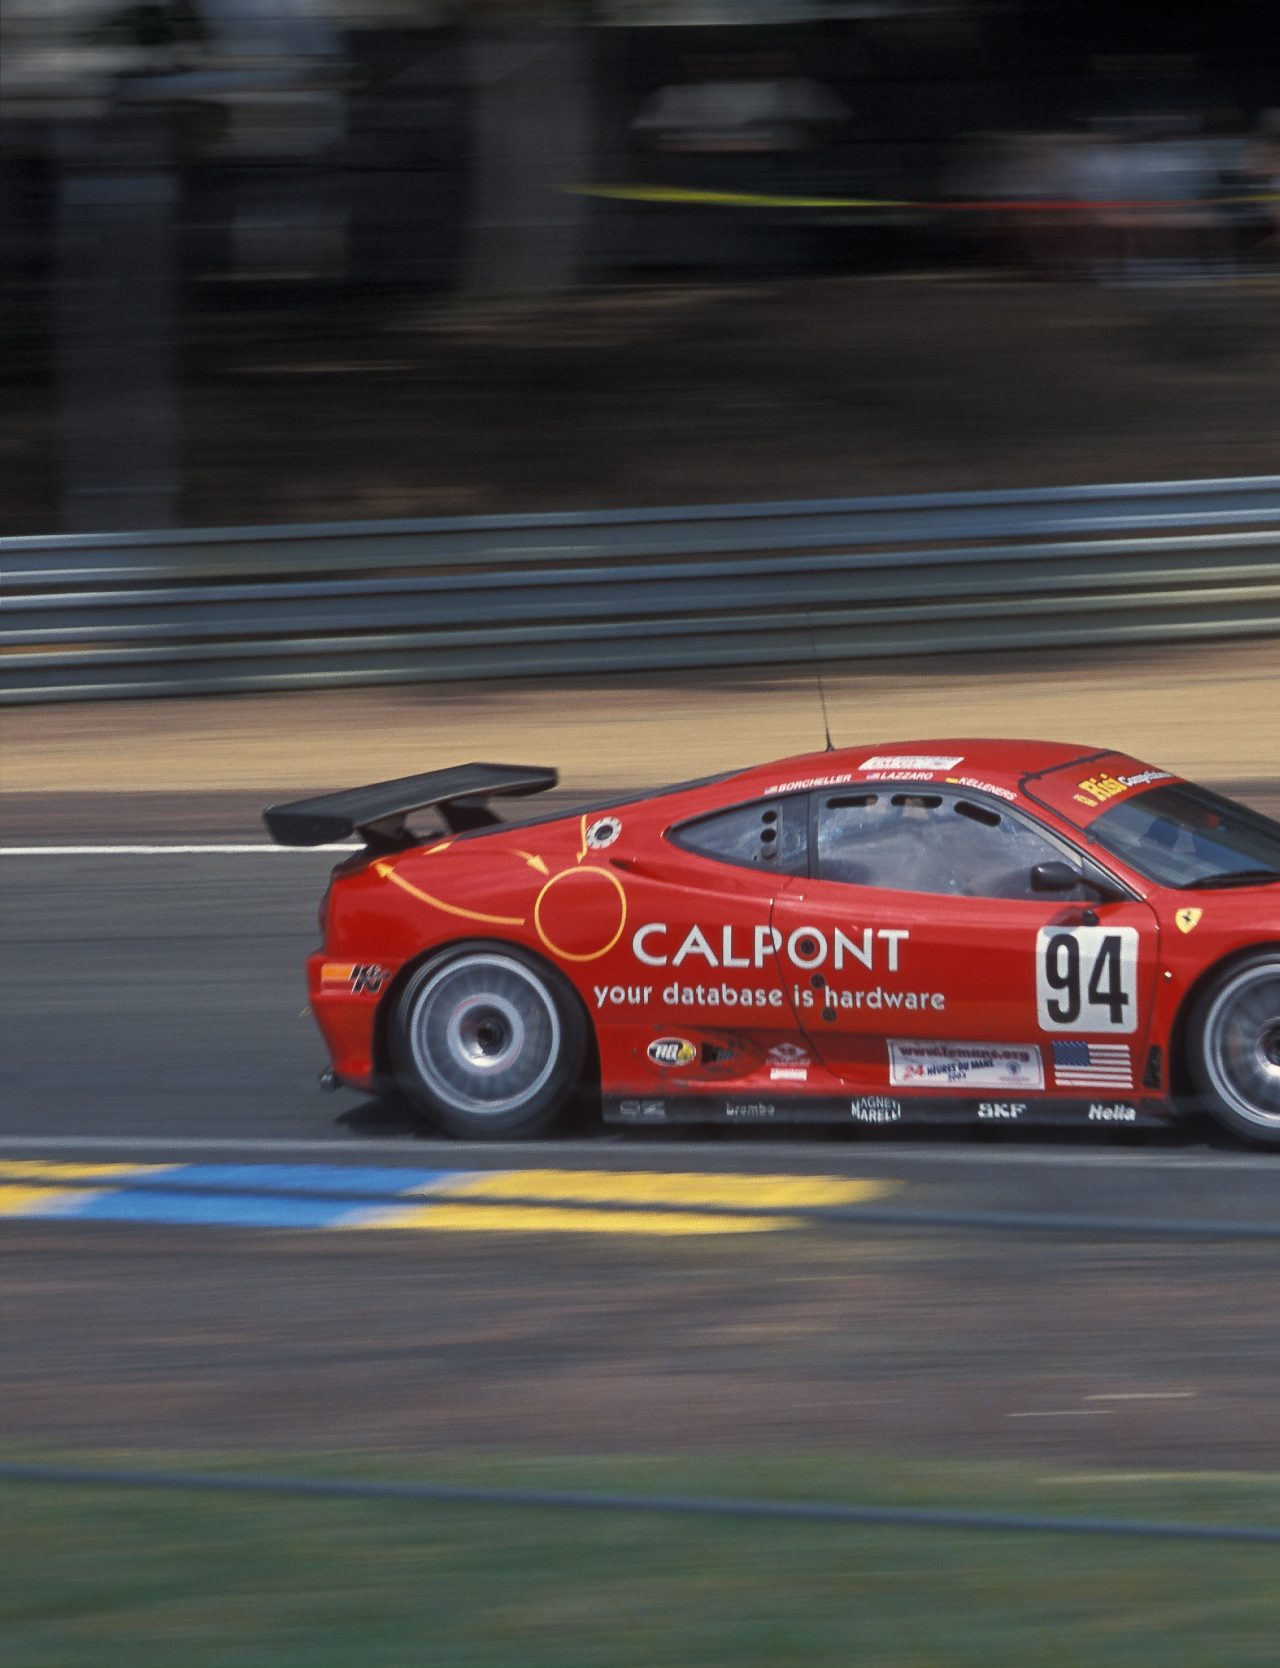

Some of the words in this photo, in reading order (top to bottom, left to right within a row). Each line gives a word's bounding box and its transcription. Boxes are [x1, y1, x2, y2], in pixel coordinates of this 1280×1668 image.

[778, 773, 852, 793] BORCHELLER
[880, 772, 934, 781] LAZZARO
[957, 777, 1018, 801] KELLENERS
[1078, 773, 1128, 802] Risi
[632, 923, 910, 972] CALPONT
[1045, 933, 1130, 1024] 94
[594, 985, 653, 1008] your
[663, 982, 784, 1007] database
[793, 983, 814, 1007] is
[824, 985, 945, 1010] hardware
[977, 1103, 1028, 1119] SKF
